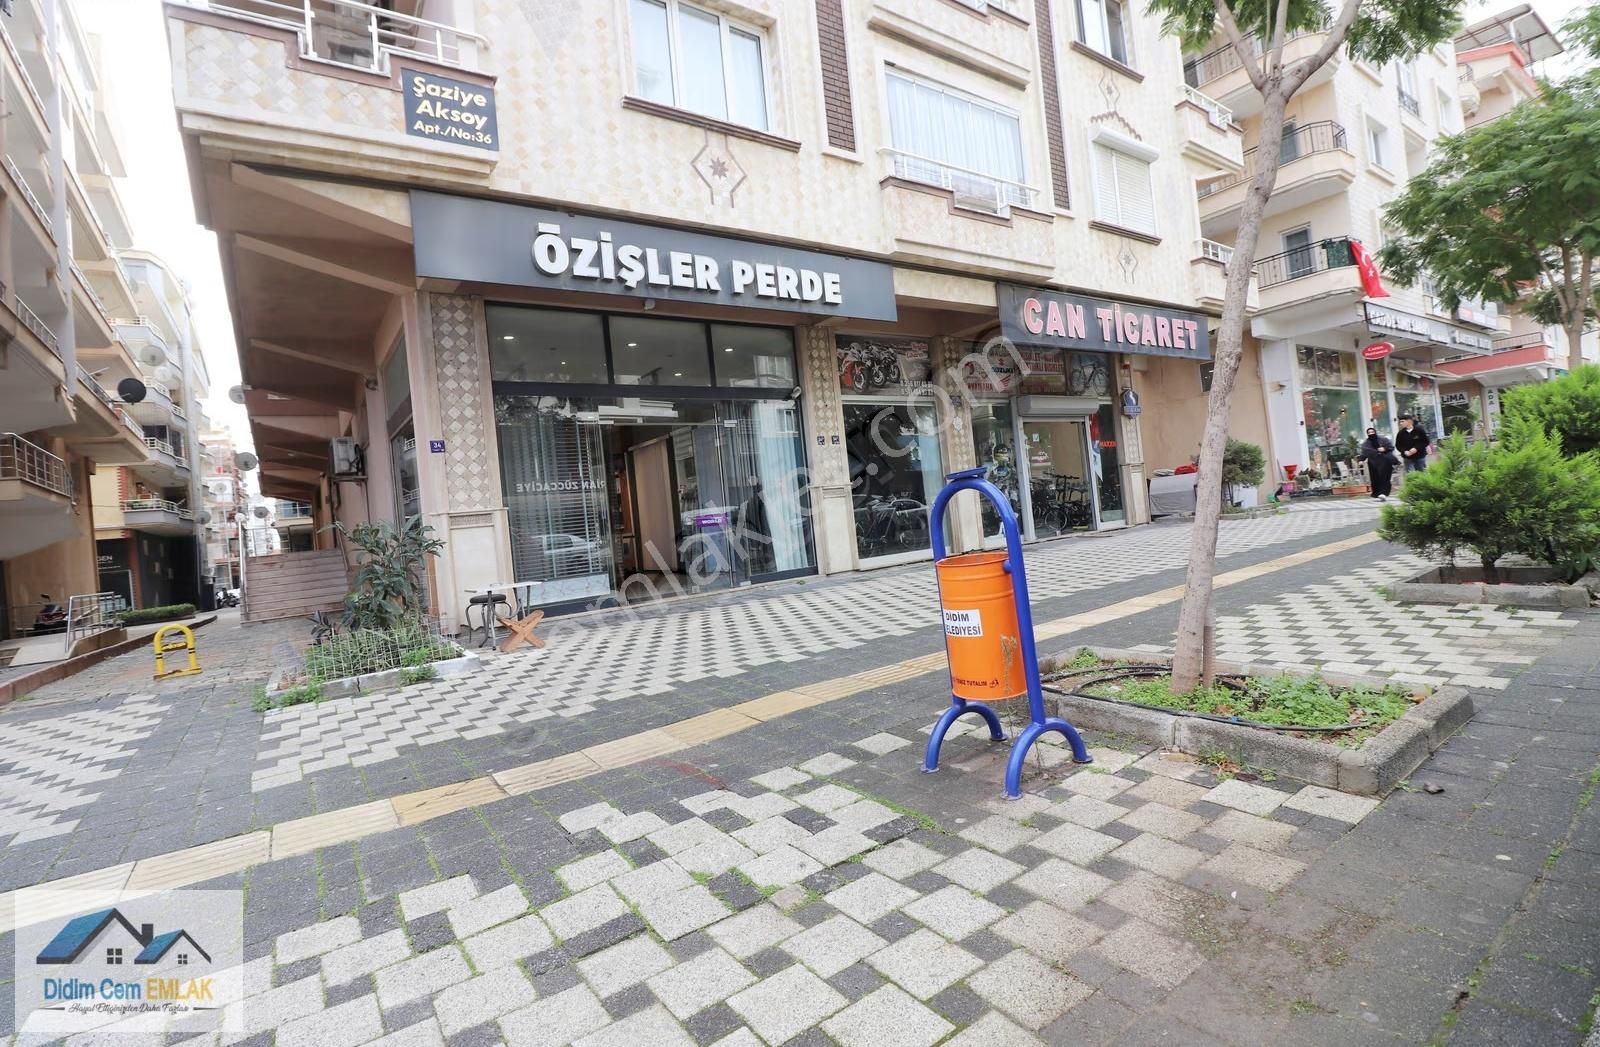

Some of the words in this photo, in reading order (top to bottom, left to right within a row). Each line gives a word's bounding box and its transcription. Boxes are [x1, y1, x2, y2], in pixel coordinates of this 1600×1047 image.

[412, 76, 488, 107] Şaziye
[416, 99, 488, 131] Aksoy
[413, 120, 492, 144] Apt./No:36
[731, 259, 843, 305] PERDE
[1023, 297, 1086, 339] CAN
[1096, 303, 1198, 350] TİCARET
[945, 612, 970, 622] DİDİM
[946, 624, 981, 636] ELEDİYESİ
